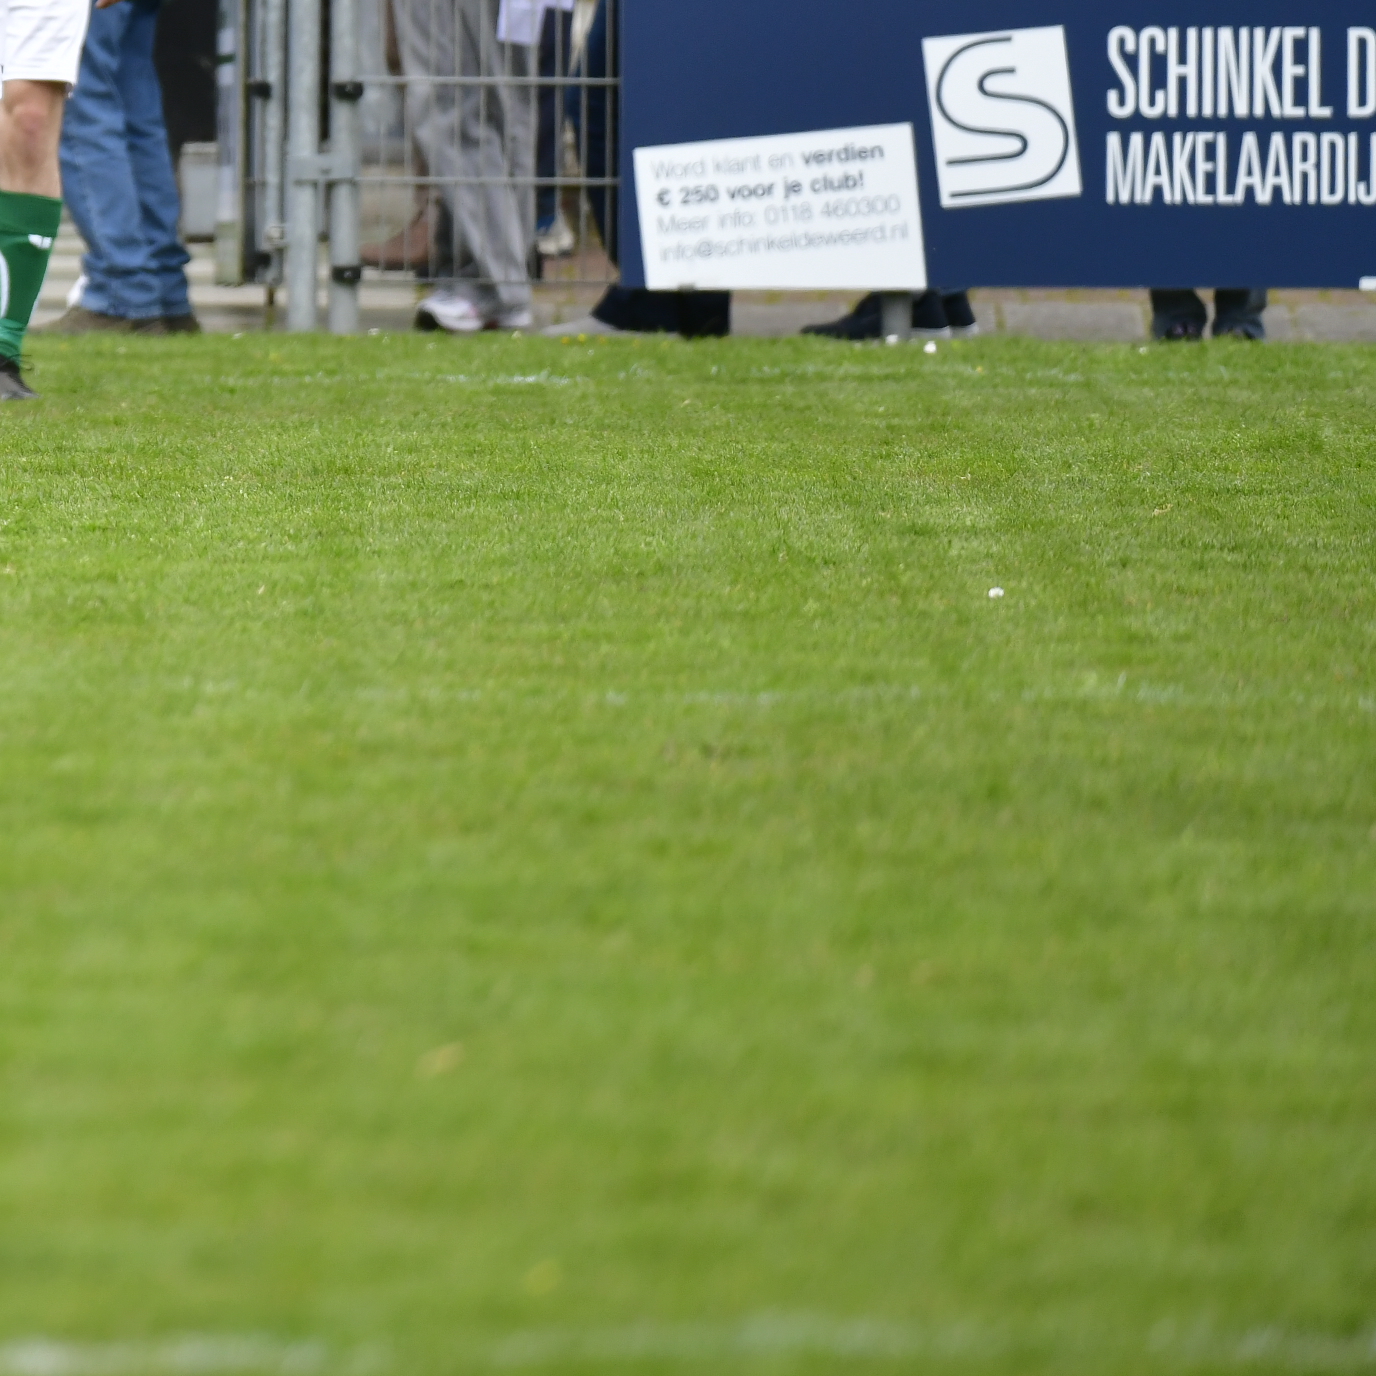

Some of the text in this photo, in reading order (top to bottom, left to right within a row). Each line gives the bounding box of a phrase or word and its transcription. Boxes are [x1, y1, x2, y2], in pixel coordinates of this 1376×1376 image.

[1105, 25, 1334, 119] SCHINKEL
[650, 142, 885, 180] Word klant en verdien
[1105, 130, 1376, 206] MAKELAARDIJ
[656, 170, 864, 207] € 250 voor je club!
[656, 214, 710, 235] Meer
[764, 201, 813, 226] 0118
